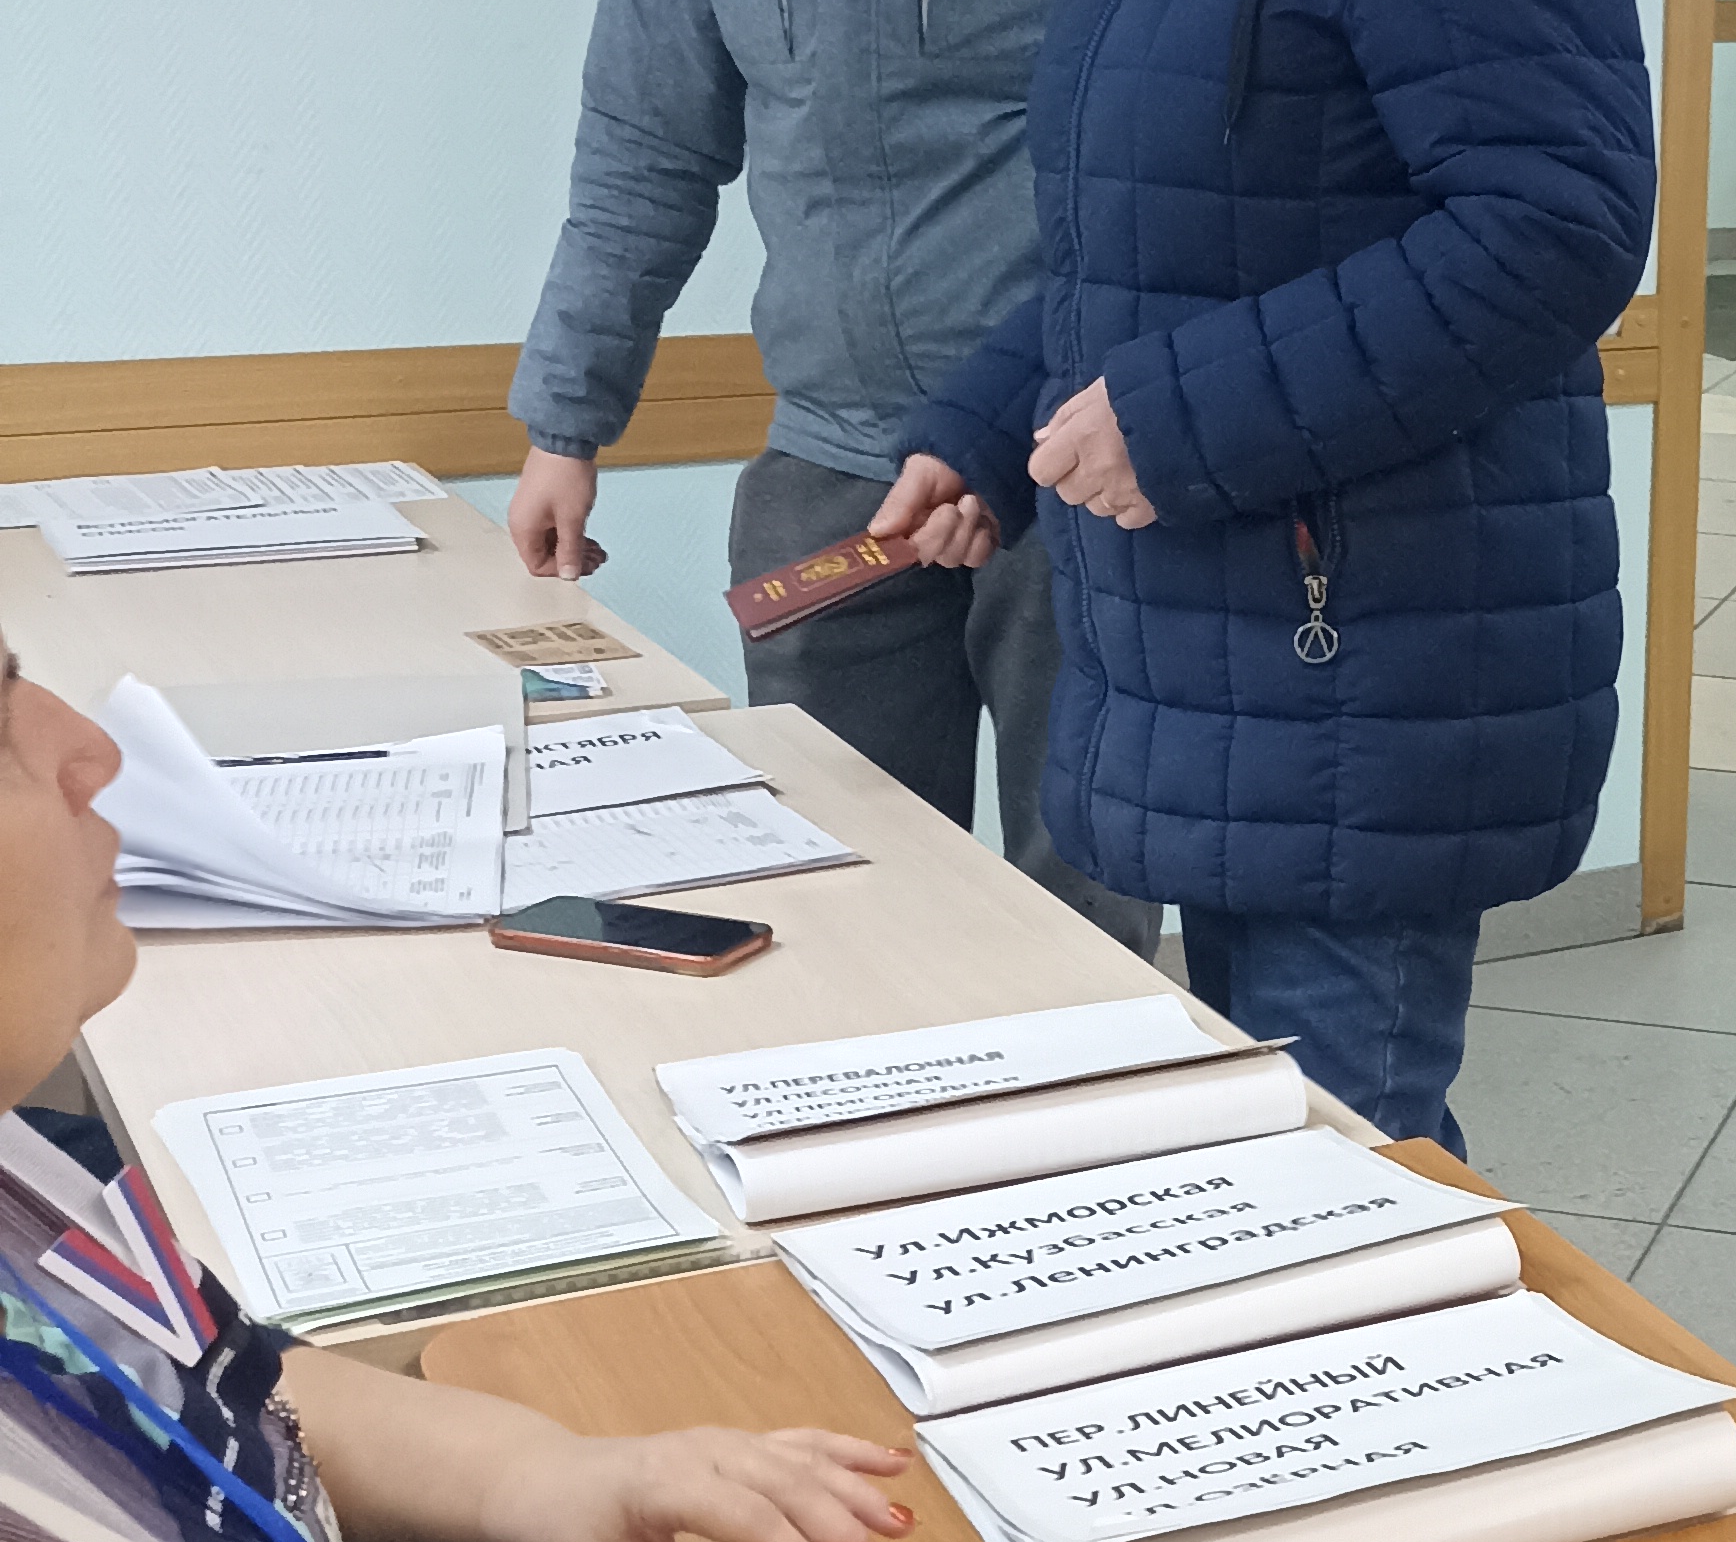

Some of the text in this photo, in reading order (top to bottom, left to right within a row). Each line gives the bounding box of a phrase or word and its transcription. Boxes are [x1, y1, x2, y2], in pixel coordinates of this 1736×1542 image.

[719, 1050, 1005, 1095] УЛ.ПЕРЕВАЛОЧНАЯ
[731, 1075, 943, 1108] УЛ.ПЕСОЧНАЯ
[1010, 1354, 1407, 1453] ПЕР.ЛИНЕЙНЫЙ
[1038, 1352, 1565, 1482] УЛ.МЕЛИОРАТИВНАЯ
[1068, 1433, 1341, 1509] УЛ.НОВАЯ
[1123, 1440, 1430, 1517] Л.ОЗЕРНАЯ
